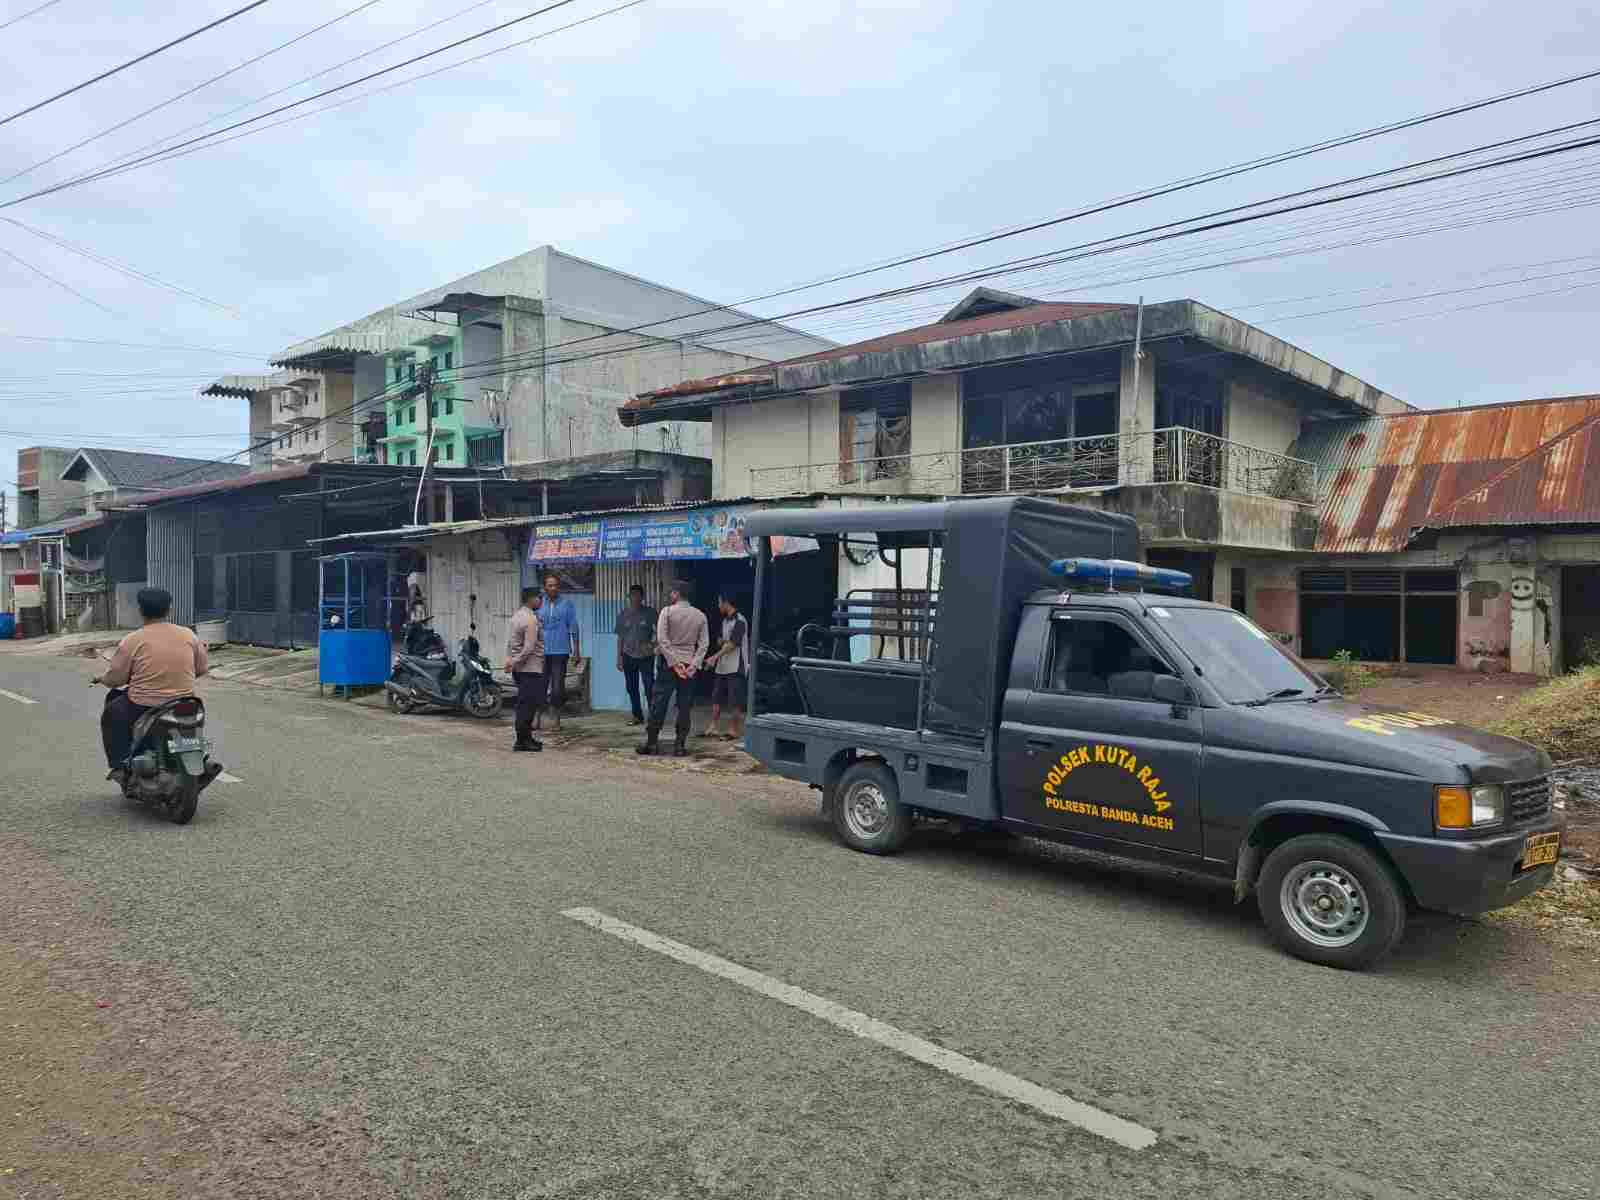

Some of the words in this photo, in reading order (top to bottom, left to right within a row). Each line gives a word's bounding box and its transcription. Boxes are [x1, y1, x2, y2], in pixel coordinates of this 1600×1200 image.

[1043, 745, 1090, 795] POLSEK
[1095, 744, 1137, 772] KUTA
[1137, 765, 1171, 812] RAJA
[1045, 797, 1099, 816] POLRESTA
[1101, 807, 1138, 824] BANDA
[1142, 815, 1174, 830] ACEH
